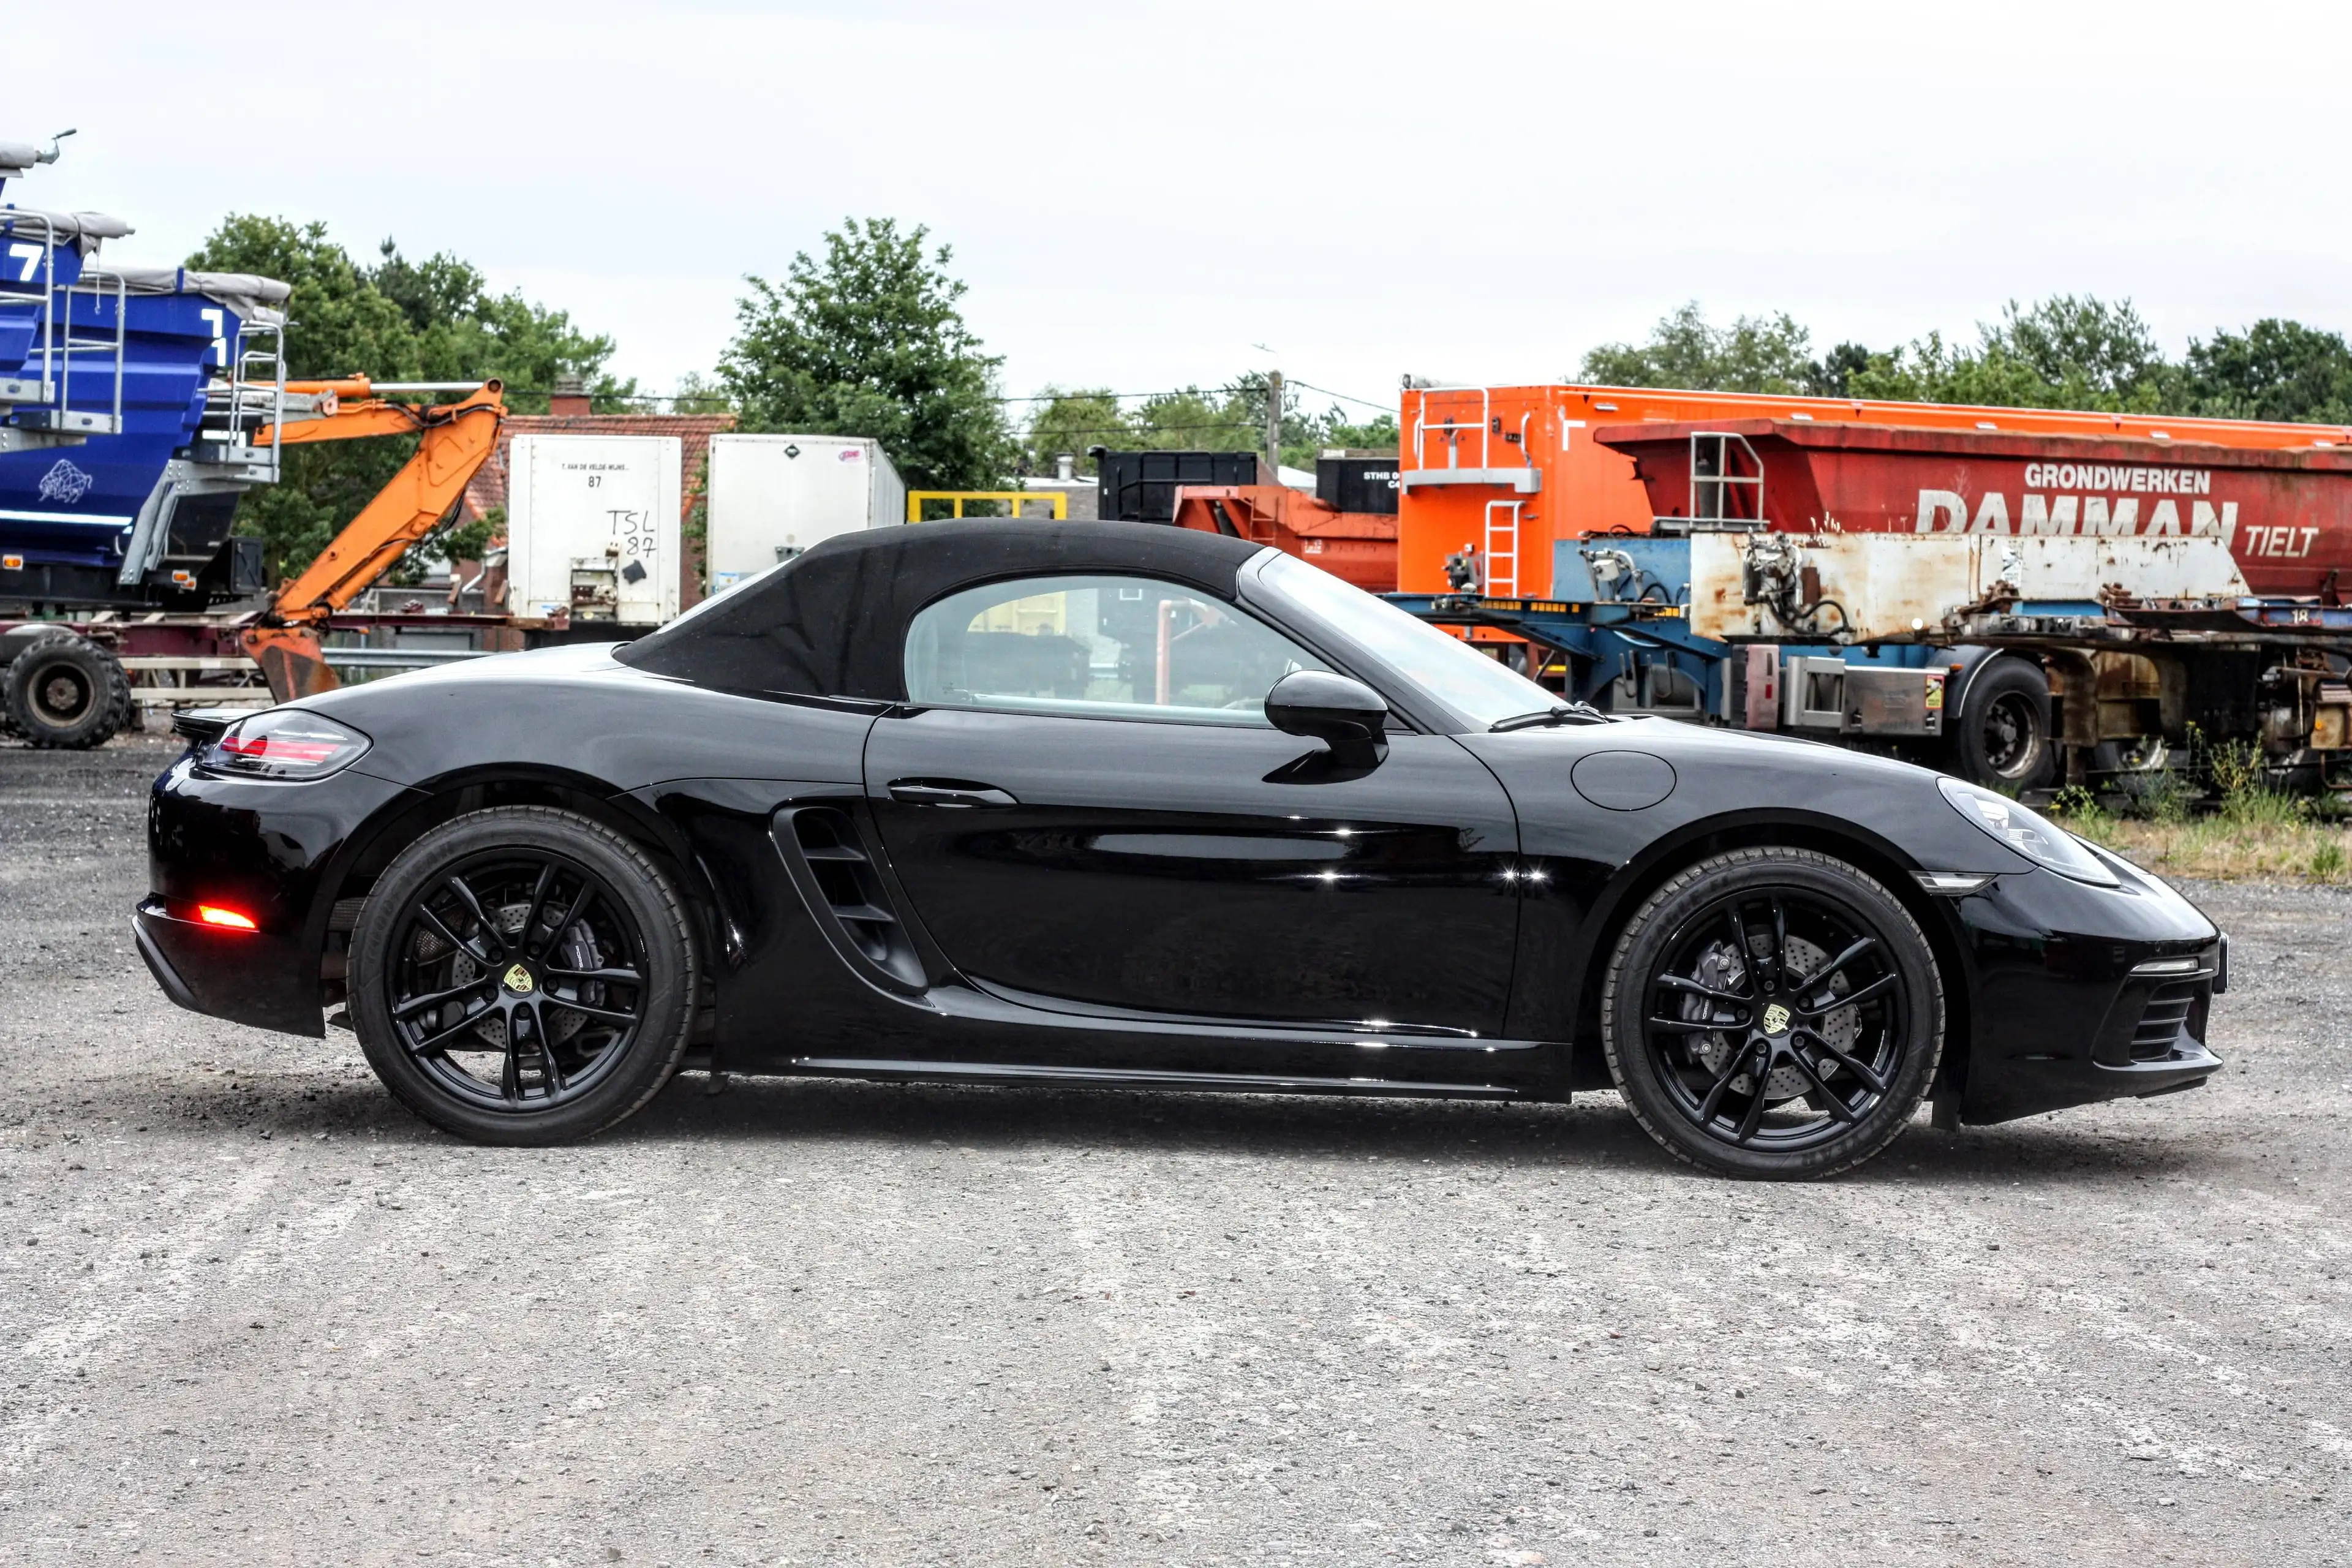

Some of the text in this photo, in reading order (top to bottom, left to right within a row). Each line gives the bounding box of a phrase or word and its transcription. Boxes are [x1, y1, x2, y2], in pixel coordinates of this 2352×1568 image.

[588, 475, 601, 488] 87
[1363, 471, 1390, 480] STHB
[2024, 462, 2211, 494] GRONDWERKEN
[606, 510, 655, 535] TSL
[1915, 489, 2319, 558] DAMMAN TIELT
[626, 537, 657, 558] 87
[2292, 608, 2309, 624] 18
